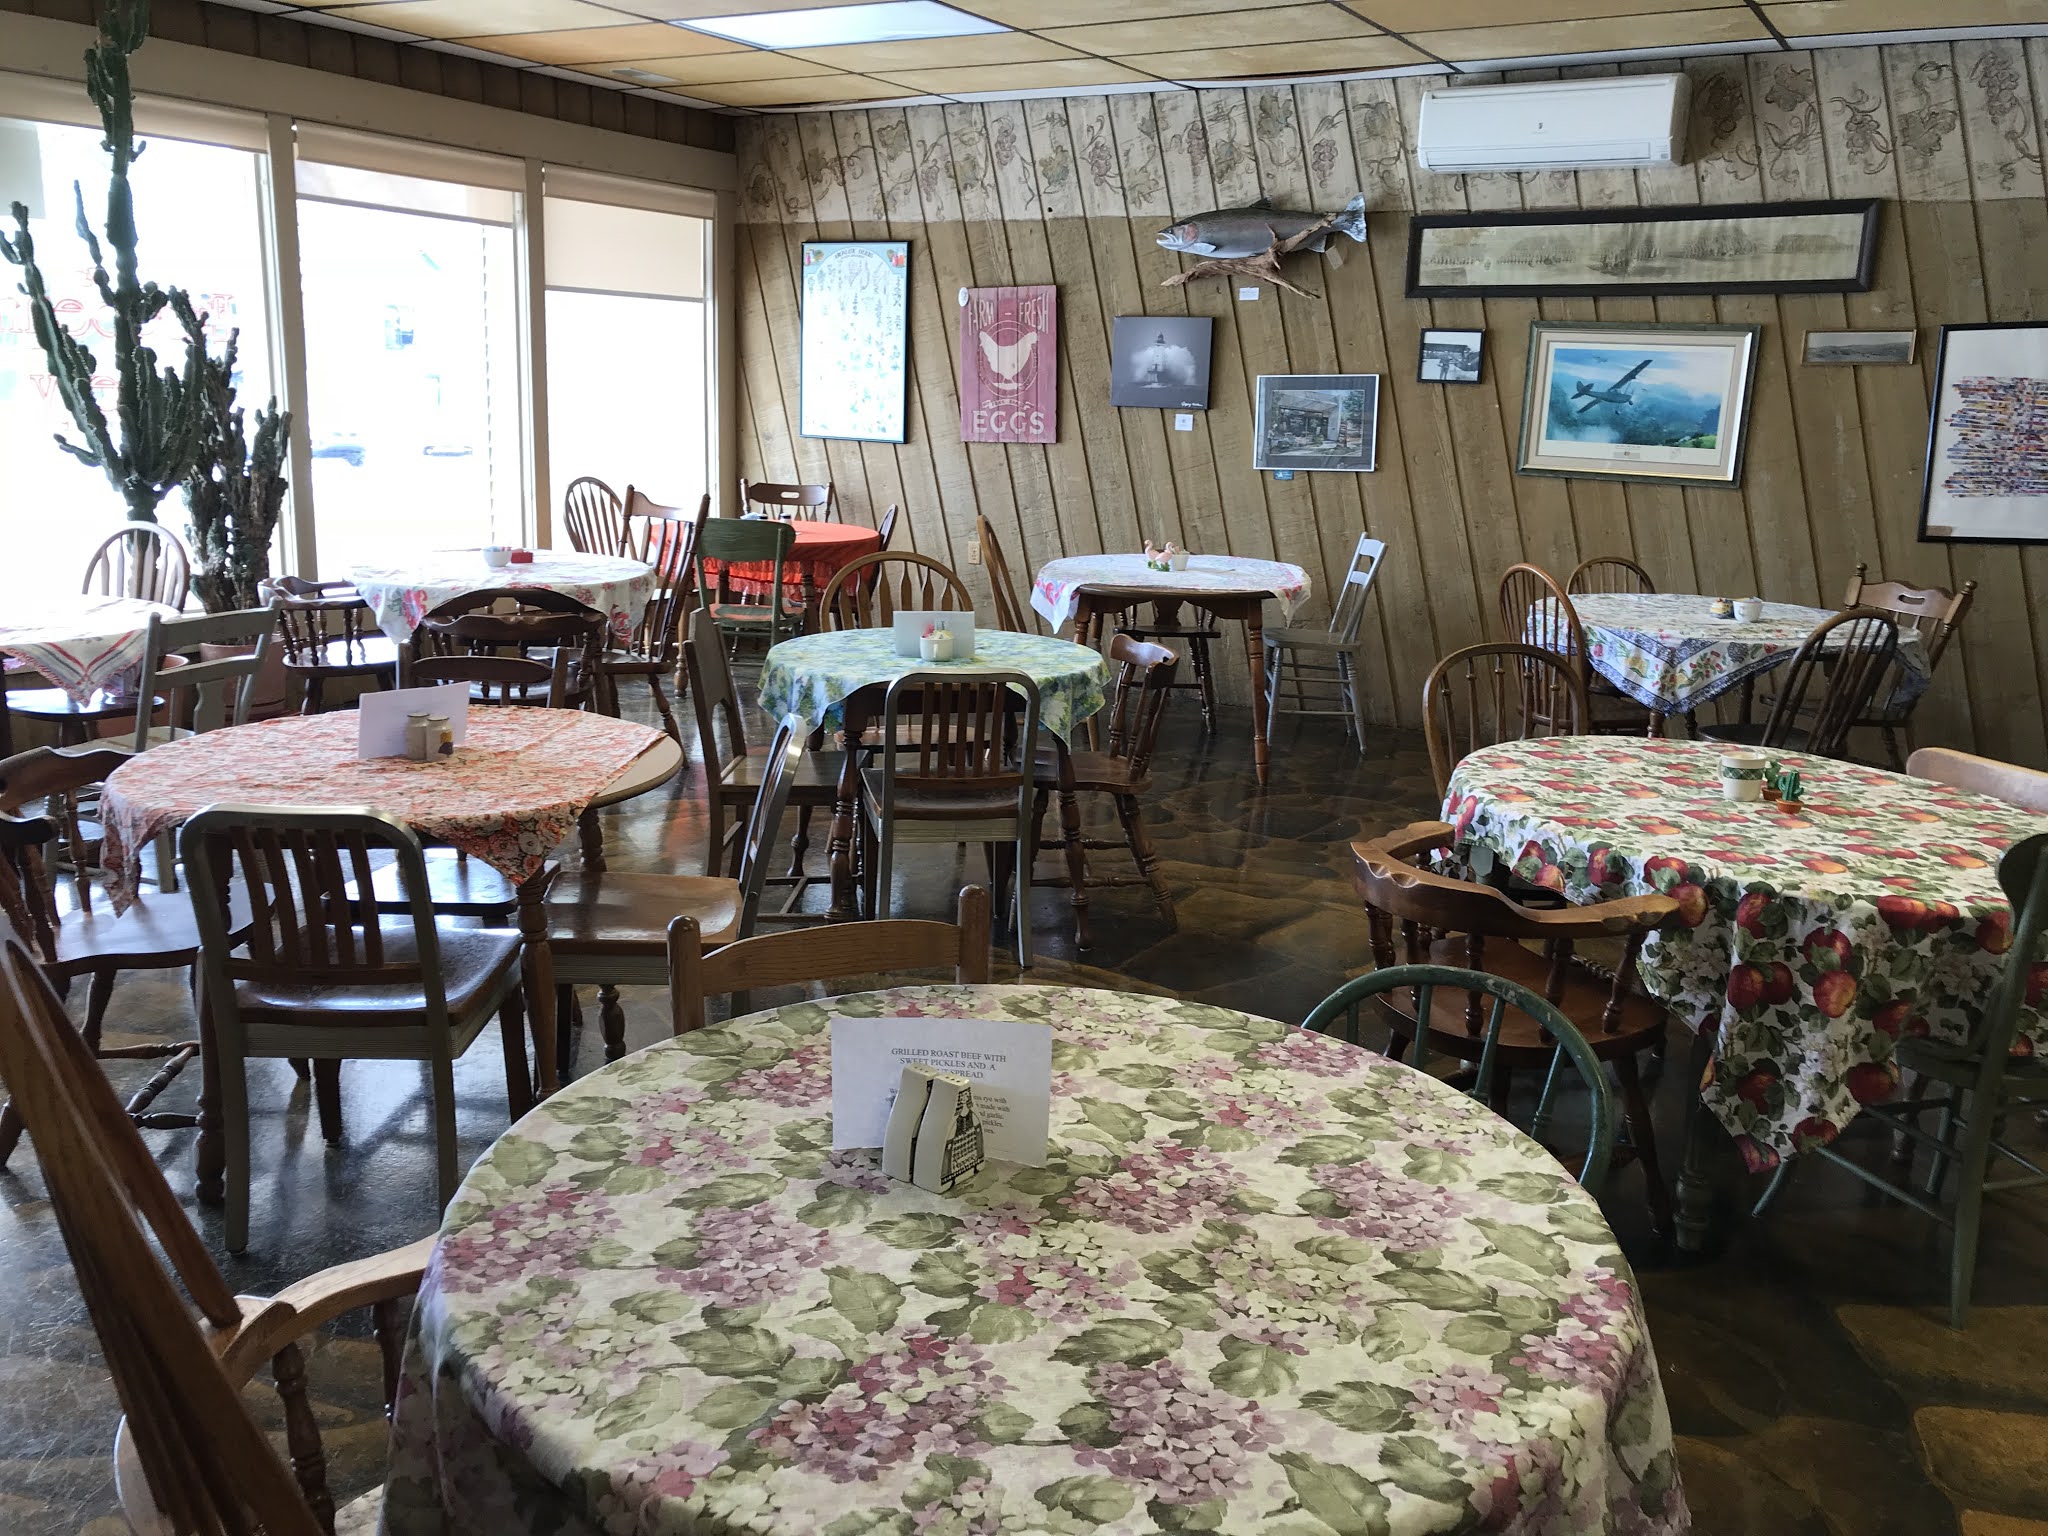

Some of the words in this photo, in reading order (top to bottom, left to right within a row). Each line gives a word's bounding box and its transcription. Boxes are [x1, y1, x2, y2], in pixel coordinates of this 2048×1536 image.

[968, 297, 995, 336] FARM
[1019, 291, 1049, 335] FRESH
[973, 410, 1045, 435] EGGS
[891, 1048, 929, 1057] GRILLED
[931, 1050, 959, 1059] ROAST
[961, 1052, 981, 1060] BEEF
[983, 1054, 1006, 1062] WITH
[931, 1059, 965, 1068] PICKLES
[967, 1061, 986, 1070] AND
